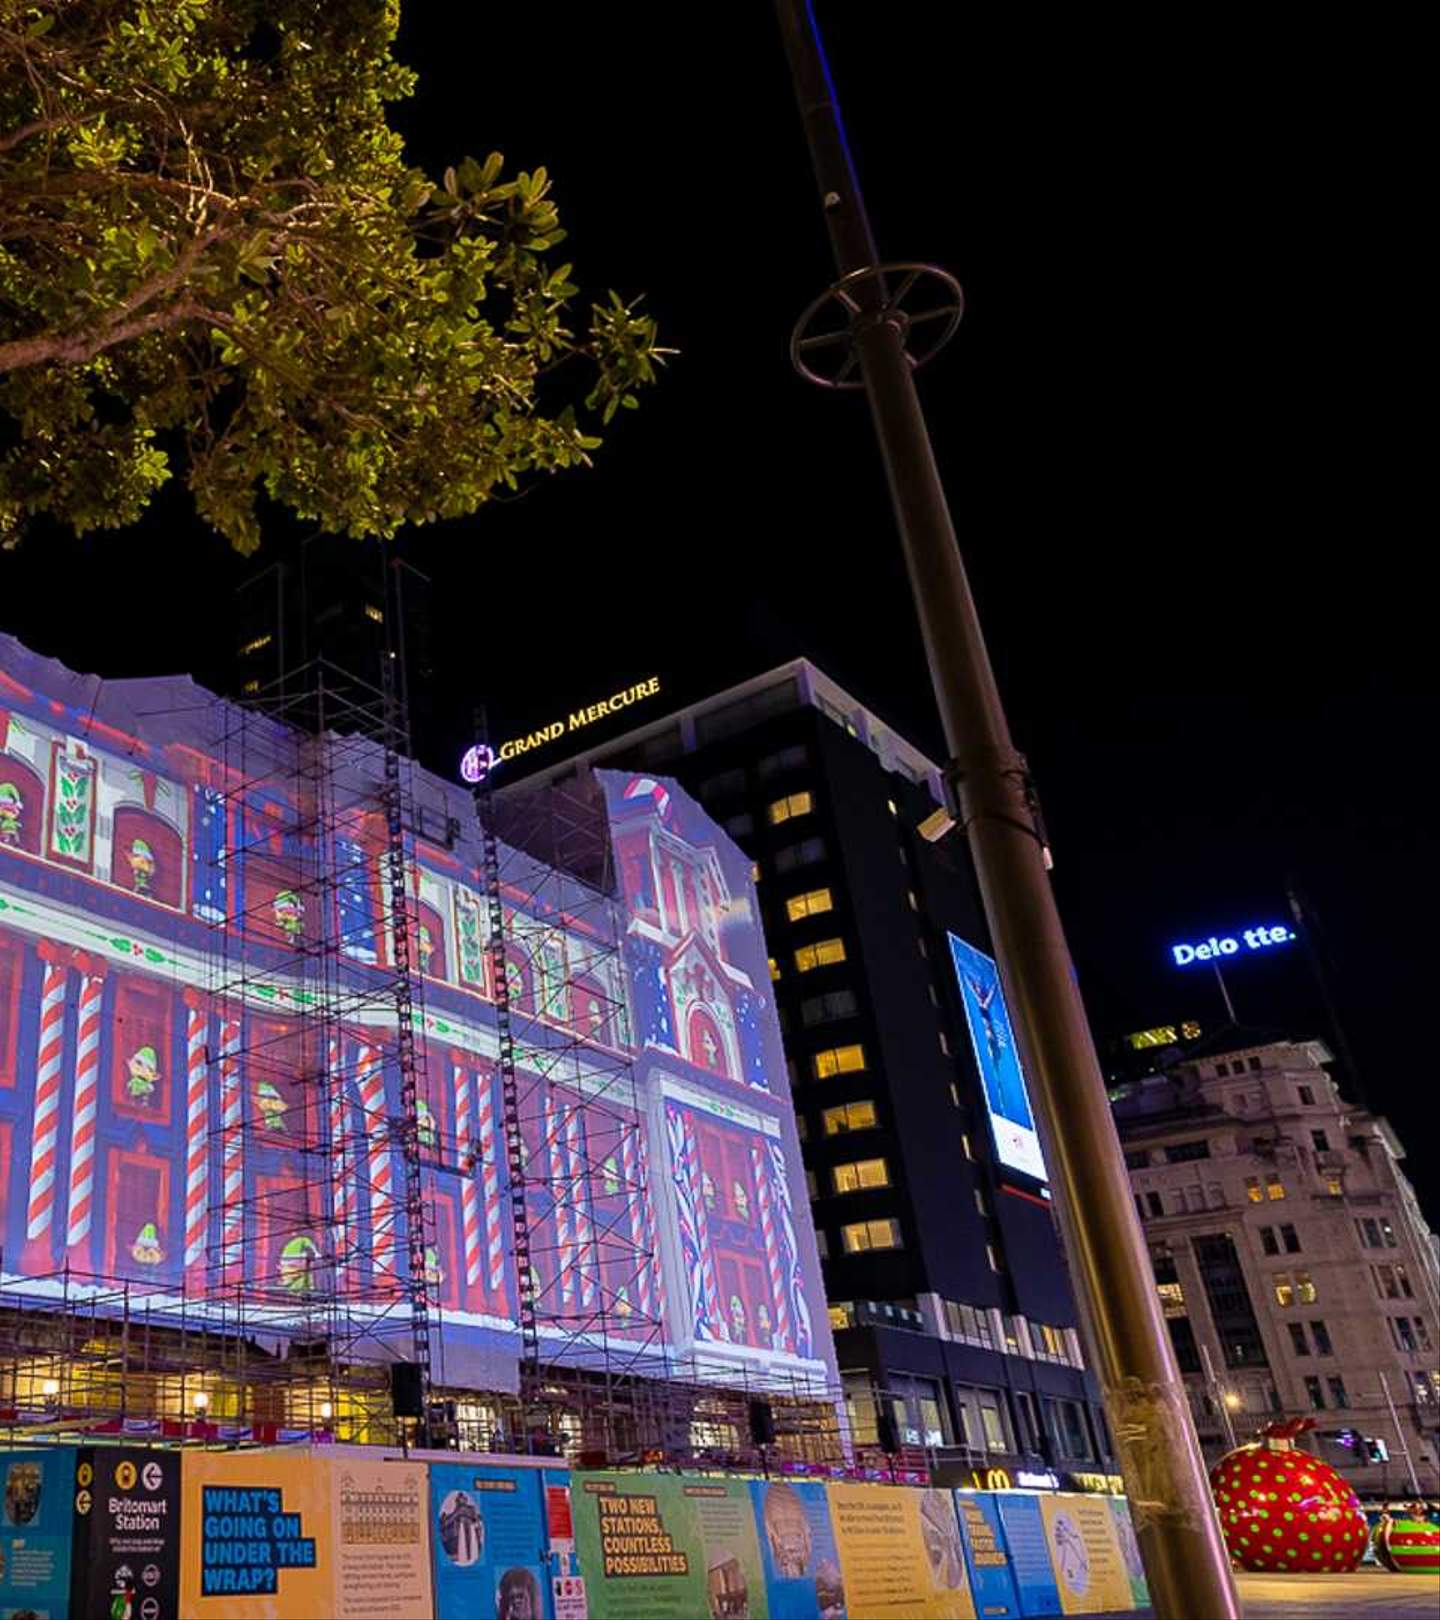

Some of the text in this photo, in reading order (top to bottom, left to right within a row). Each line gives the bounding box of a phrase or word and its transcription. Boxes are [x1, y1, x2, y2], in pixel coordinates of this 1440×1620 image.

[500, 676, 661, 760] GRAND MERCURE
[1172, 926, 1297, 966] Delotte.
[109, 1497, 167, 1514] Britomart
[204, 1489, 279, 1513] WHAT'S
[600, 1496, 656, 1515] TWO NEW
[115, 1513, 160, 1530] Station
[205, 1515, 299, 1538] GOING ON
[601, 1516, 663, 1537] STATIONS,
[205, 1541, 313, 1564] UNDER THE
[603, 1536, 672, 1555] COUNTLESS
[605, 1555, 687, 1575] POSSIBILITIES
[204, 1567, 275, 1593] WRAP?
